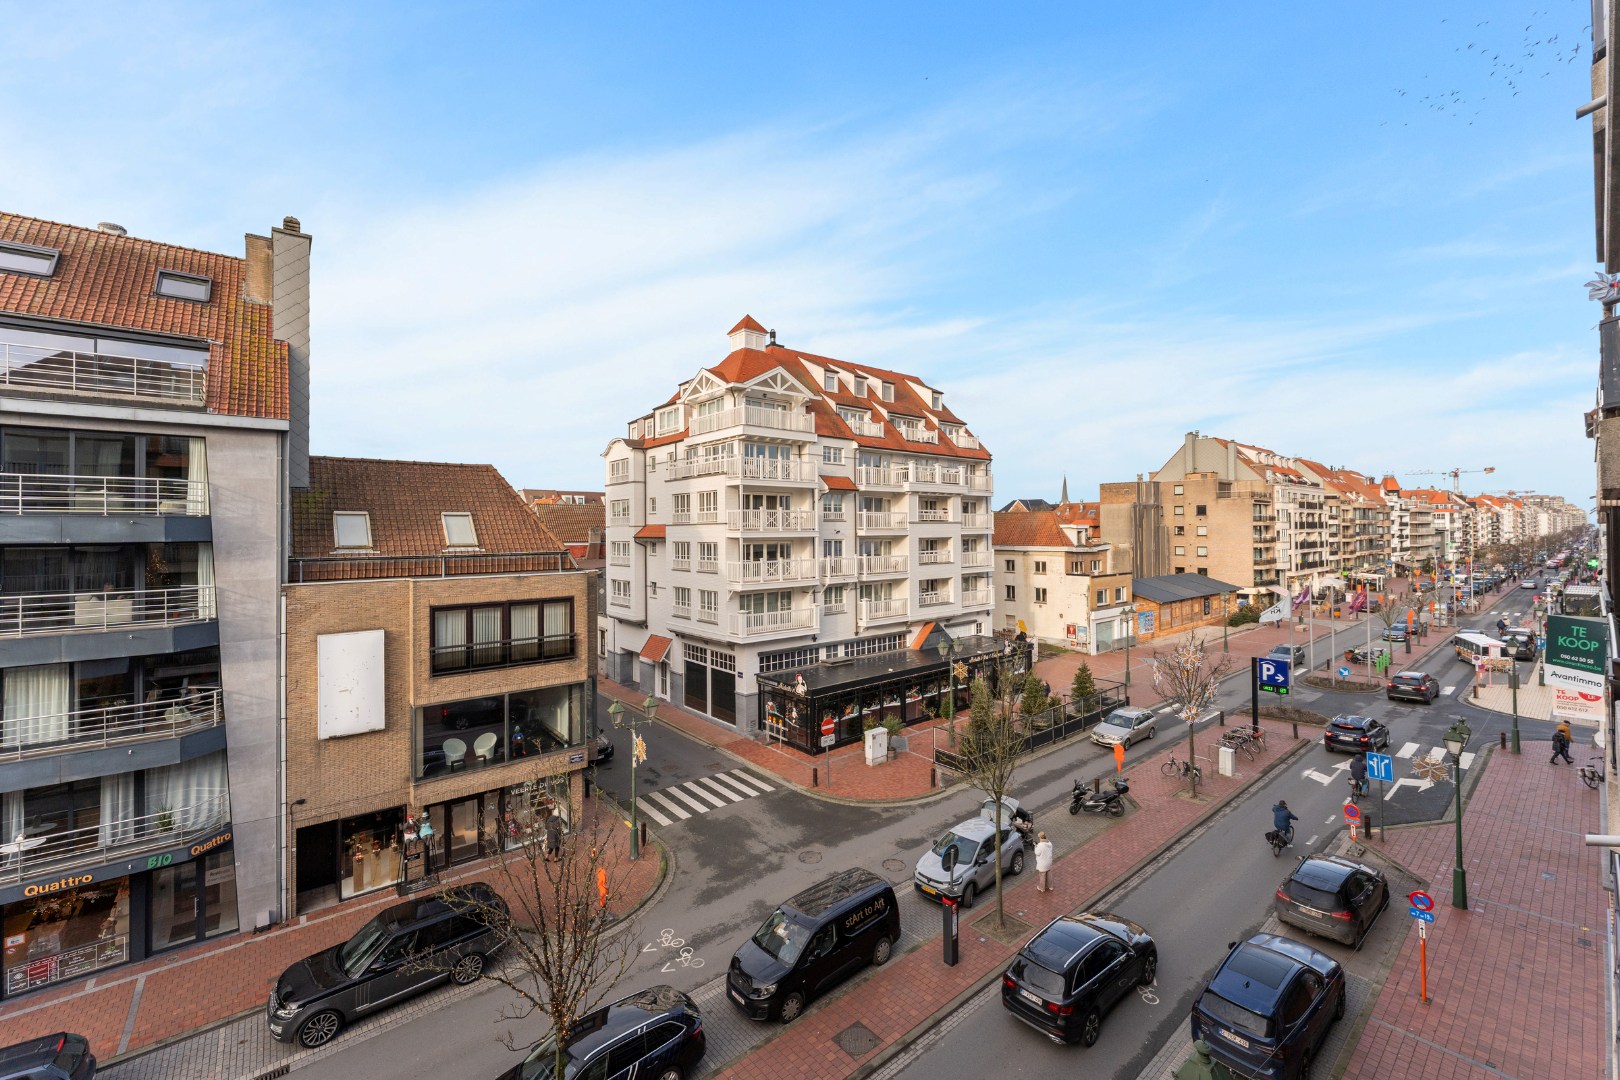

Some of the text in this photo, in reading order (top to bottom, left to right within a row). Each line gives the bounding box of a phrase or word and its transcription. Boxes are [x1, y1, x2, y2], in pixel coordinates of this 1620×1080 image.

[1571, 626, 1587, 638] TE
[1558, 636, 1599, 652] KOOP
[1262, 664, 1274, 680] P
[1550, 670, 1602, 688] Avantimmo
[190, 832, 232, 857] Quattro
[147, 853, 174, 870] BIO
[24, 874, 92, 897] Quattro
[845, 910, 864, 928] stArt
[864, 906, 873, 916] to
[874, 897, 885, 911] Art
